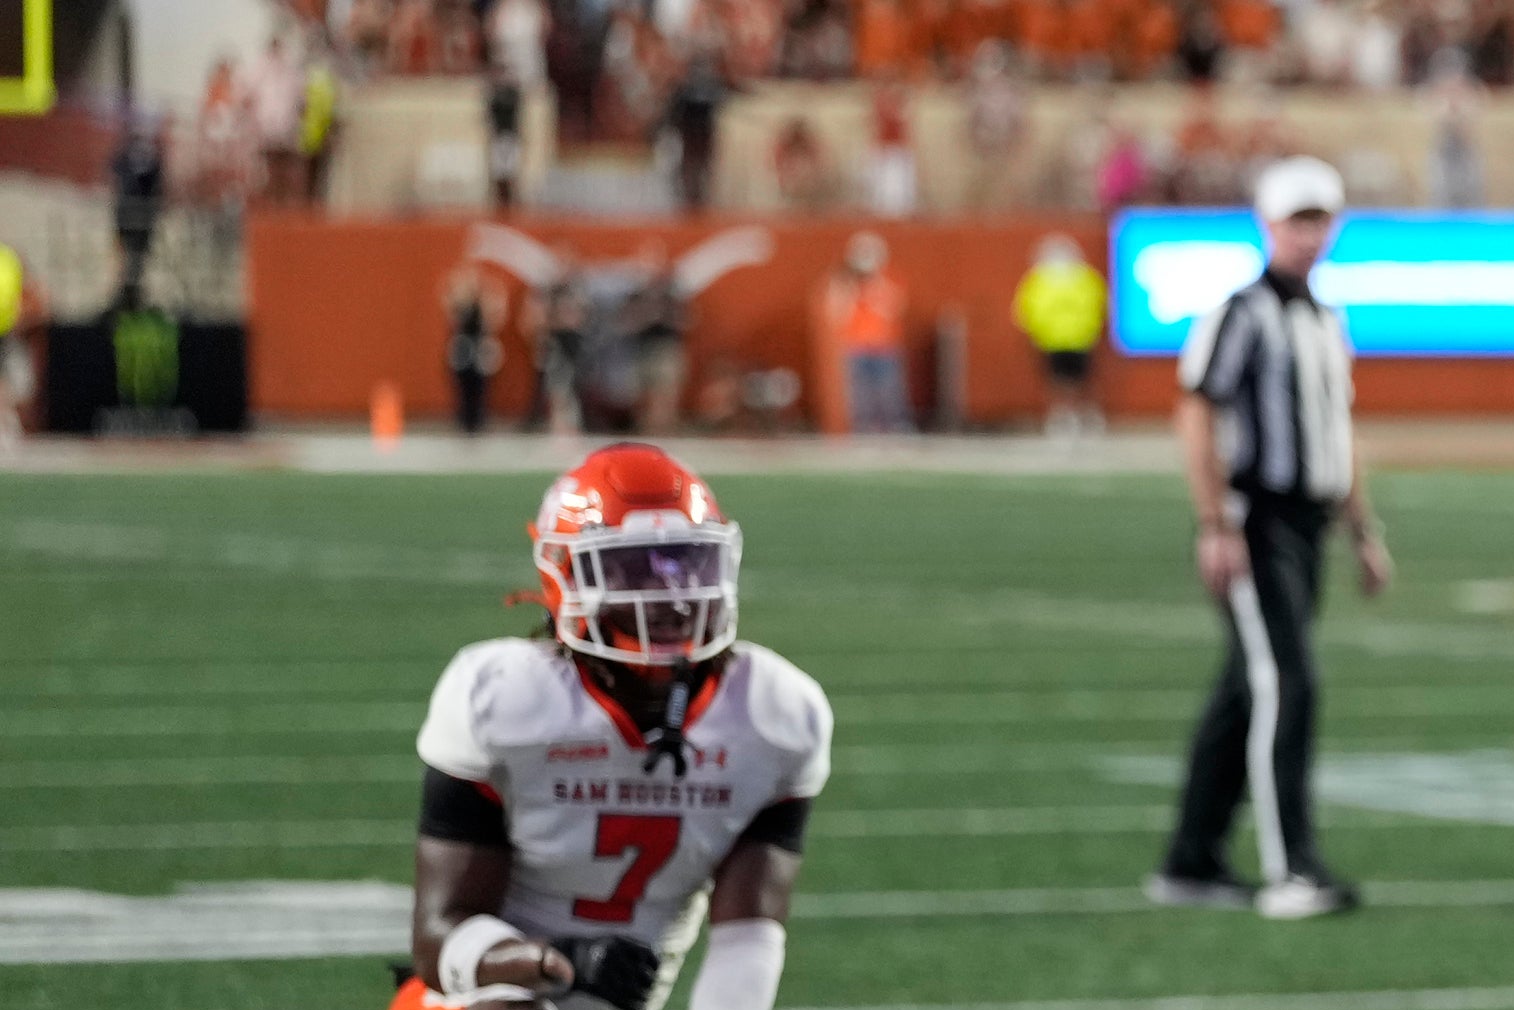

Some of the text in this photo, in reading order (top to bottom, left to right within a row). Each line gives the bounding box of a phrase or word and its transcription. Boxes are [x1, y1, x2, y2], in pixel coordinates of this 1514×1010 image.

[553, 782, 732, 803] SAM HOUSTON
[572, 813, 682, 923] 7
